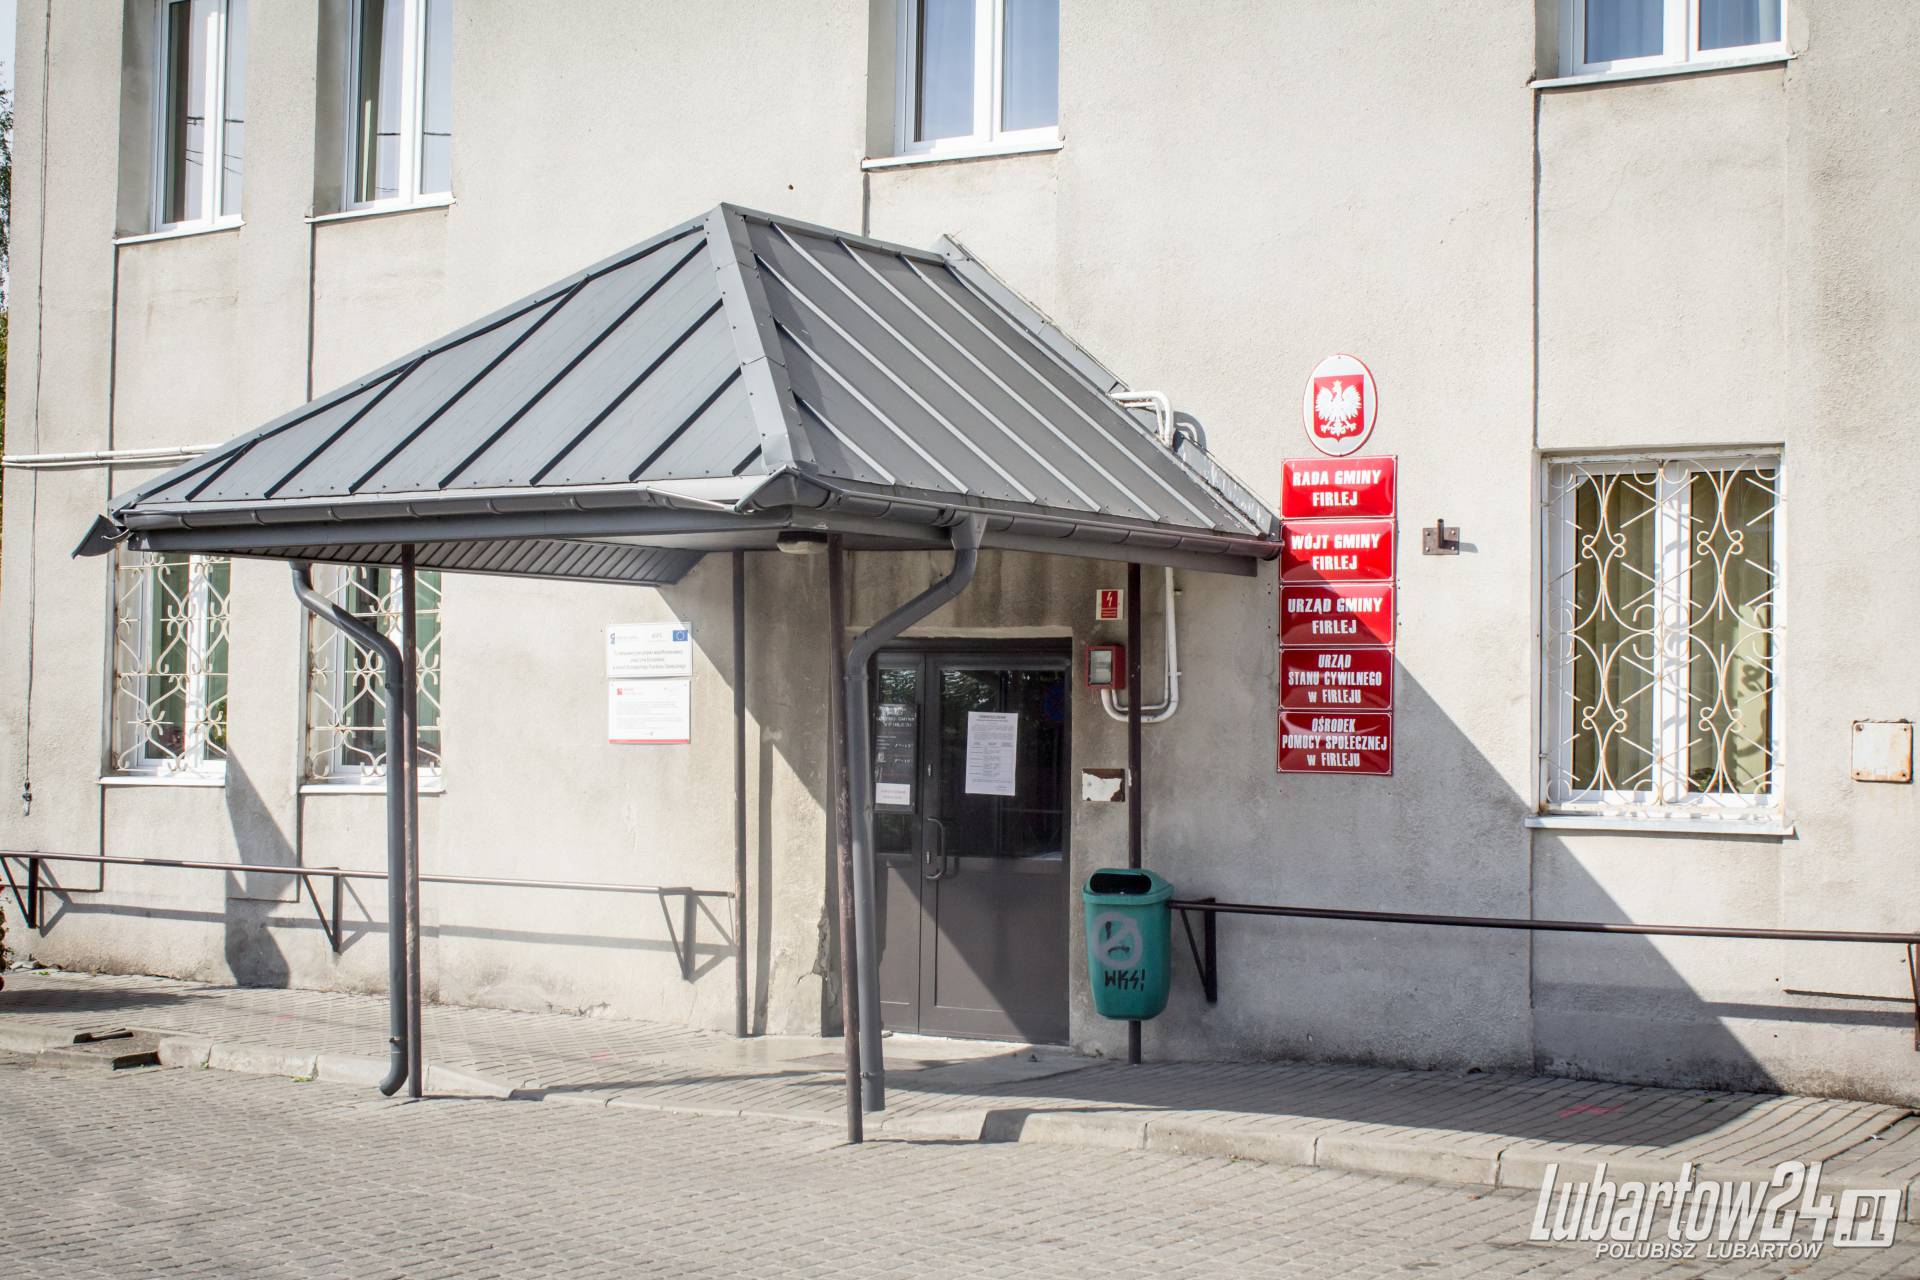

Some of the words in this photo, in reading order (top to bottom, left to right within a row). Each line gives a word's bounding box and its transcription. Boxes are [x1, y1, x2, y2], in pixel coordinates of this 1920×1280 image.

[1292, 471, 1329, 487] RADA
[1334, 469, 1382, 486] GMINY
[1312, 491, 1358, 507] FIRLEJ
[1291, 533, 1329, 550] WÓJT
[1333, 533, 1380, 549] GMINY
[1312, 555, 1358, 570] FIRLEJ
[1288, 598, 1332, 614] URZĄD
[1336, 597, 1383, 613] GMINY
[1312, 619, 1357, 634] FIRLEJ
[1318, 654, 1352, 670] URZĄD
[1288, 671, 1320, 686] STANU
[1323, 671, 1382, 686] CYWILNEGO
[1322, 689, 1362, 704] FIRLEJU
[1311, 716, 1356, 733] OŚRODEK
[1282, 734, 1320, 749] POMOCY
[1321, 752, 1361, 767] FIRLEJU
